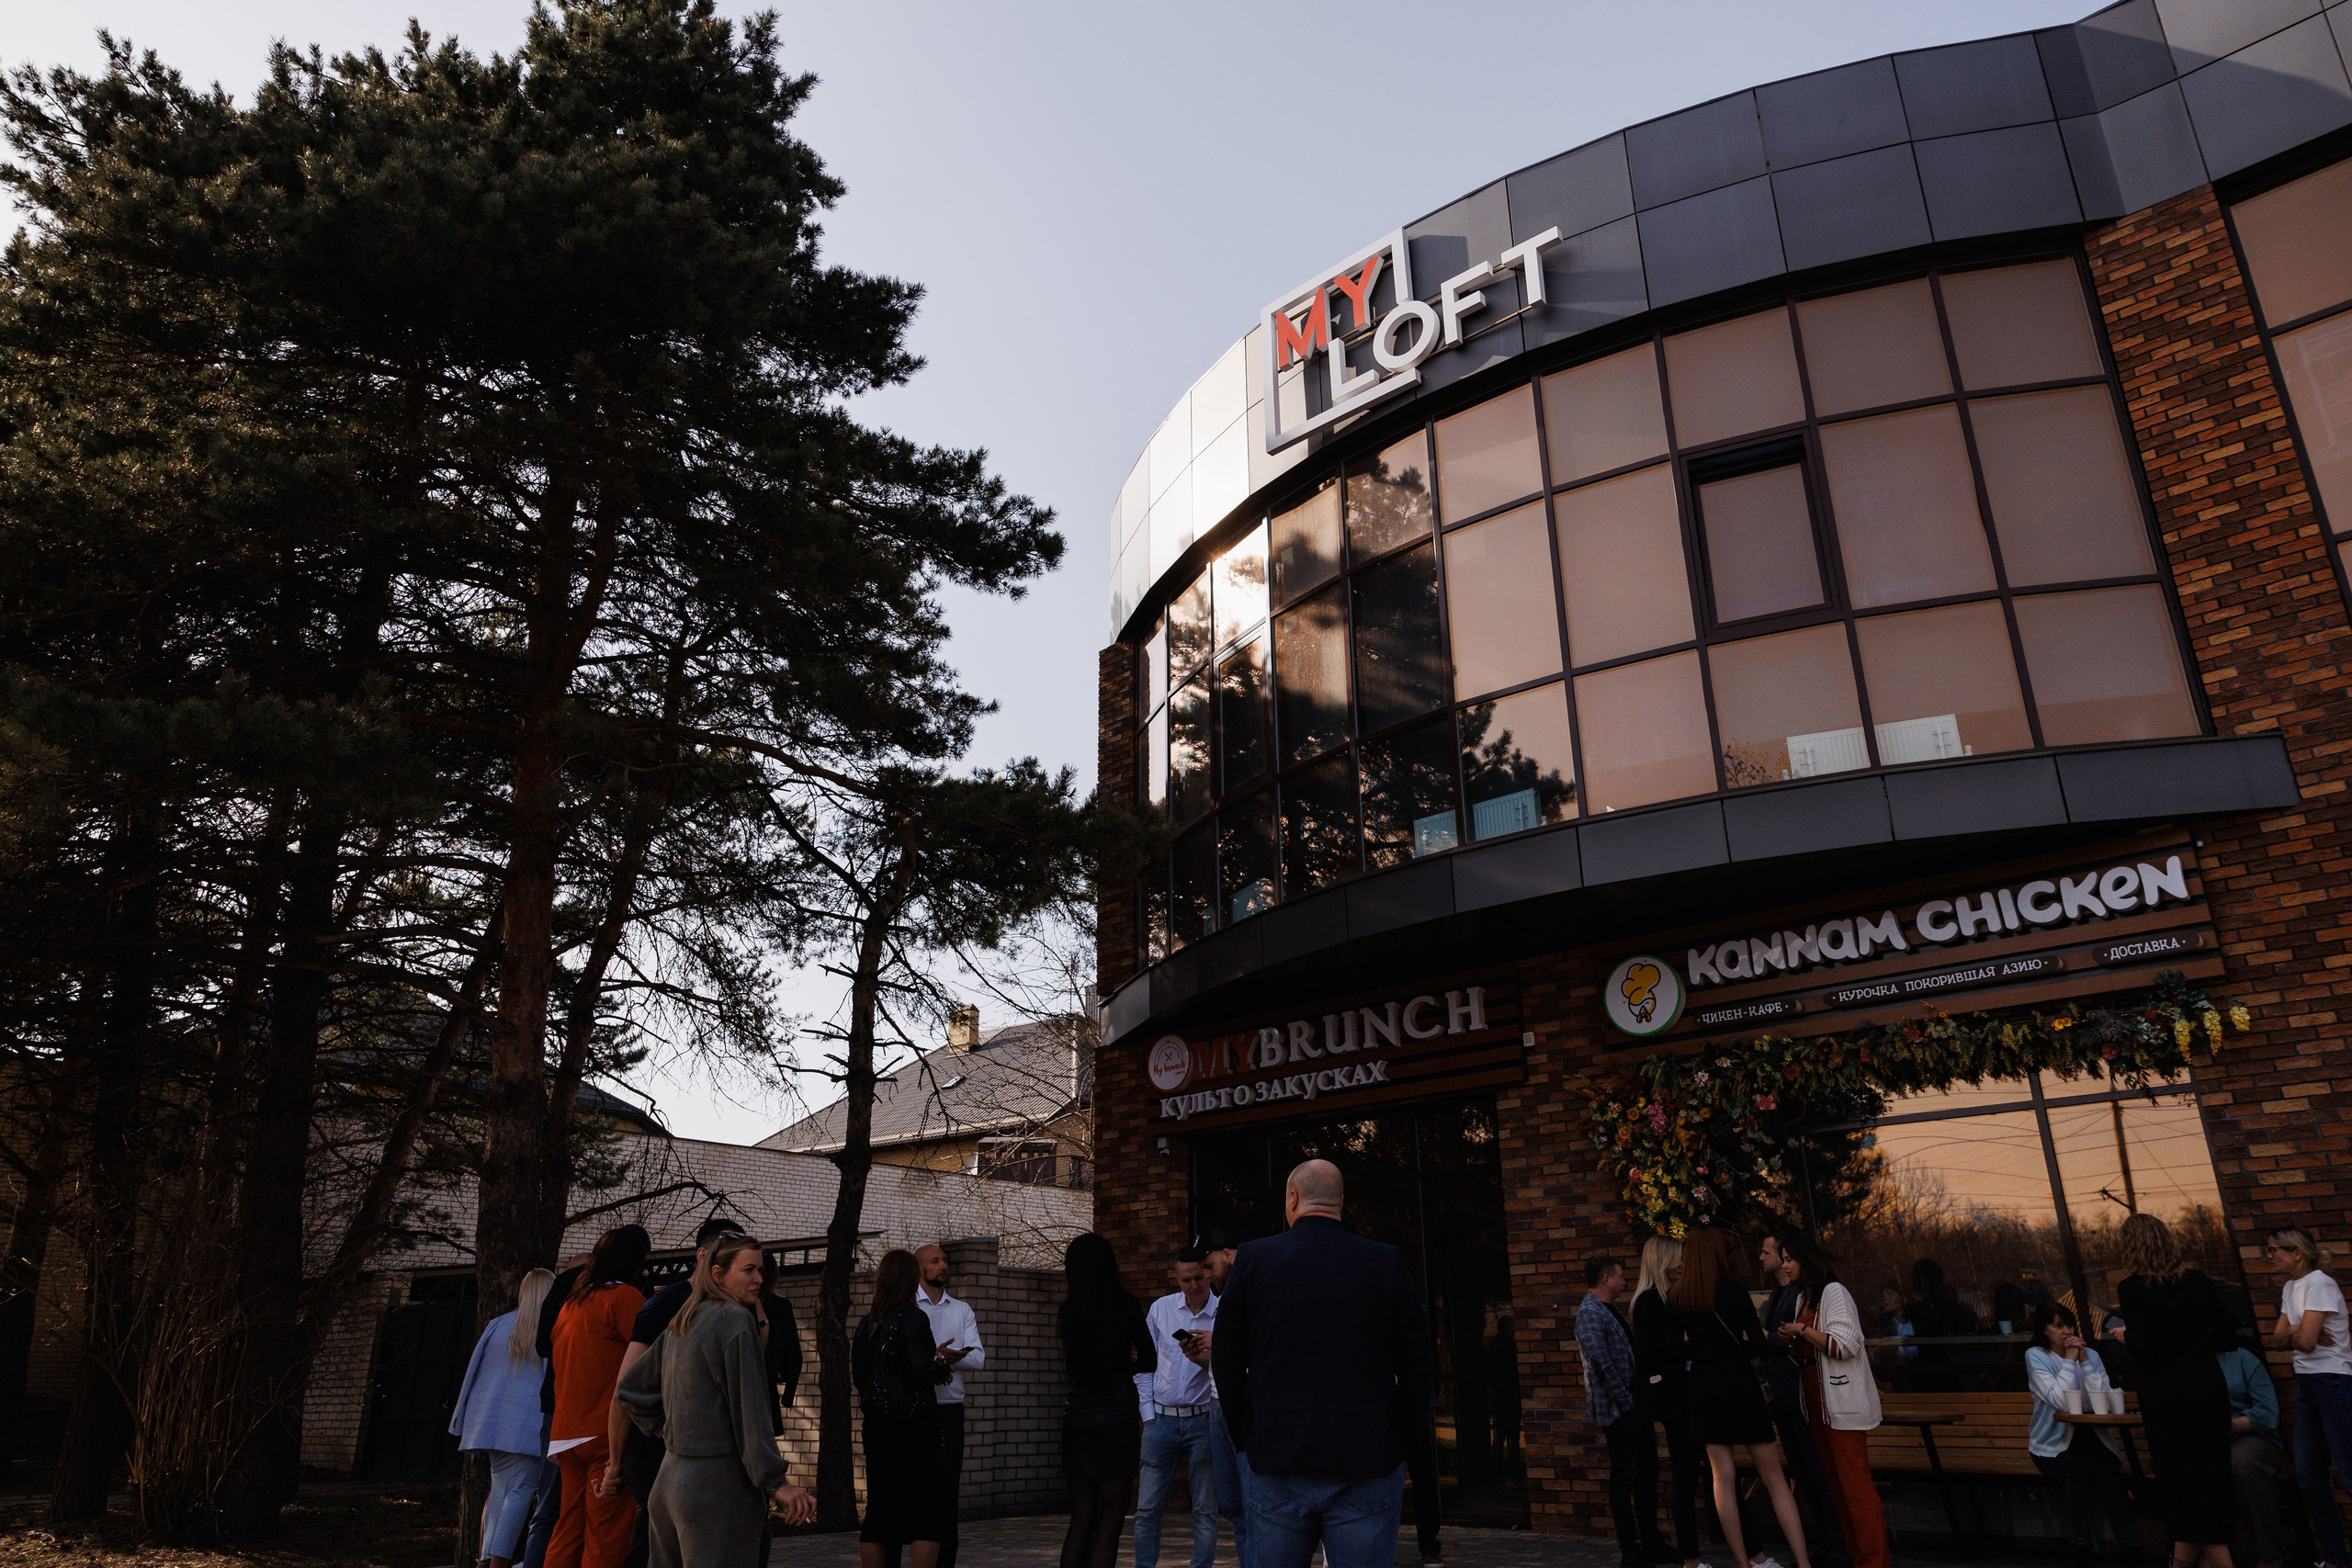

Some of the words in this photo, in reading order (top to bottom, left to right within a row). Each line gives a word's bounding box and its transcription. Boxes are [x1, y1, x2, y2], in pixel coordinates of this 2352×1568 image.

[1276, 255, 1385, 371] MY
[1329, 226, 1563, 405] LOFT
[2109, 938, 2181, 961] ДОСТАВКА
[1838, 983, 1899, 1002] КУРОЧКА
[1905, 965, 1996, 992] ПОКОРИВШАЯ
[2002, 958, 2042, 976] АЗИЮ
[1702, 1001, 1783, 1024] ЧИКЕН-КАФЕ
[1256, 1060, 1389, 1100] ЗАКУСКАХ
